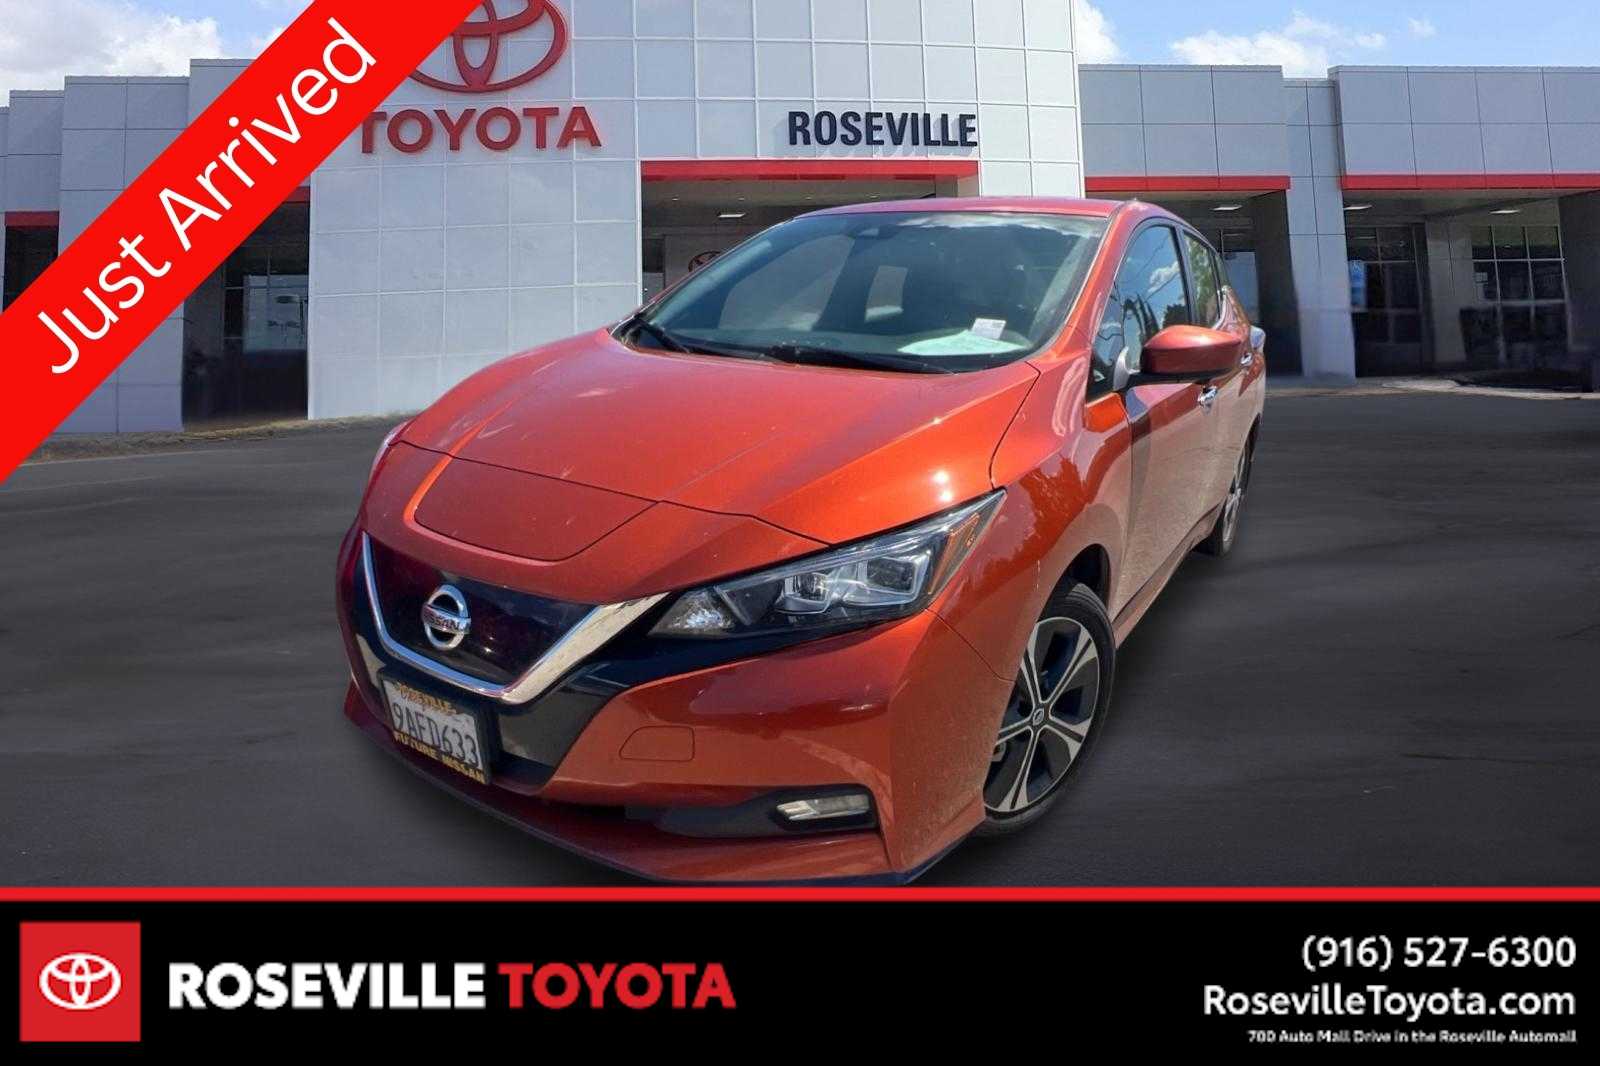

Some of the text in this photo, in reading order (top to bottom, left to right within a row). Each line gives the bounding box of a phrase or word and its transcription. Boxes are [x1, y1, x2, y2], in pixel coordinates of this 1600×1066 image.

[360, 105, 602, 154] TOYOTA
[788, 110, 978, 147] ROSEVILLE
[392, 702, 480, 769] 9AFD633
